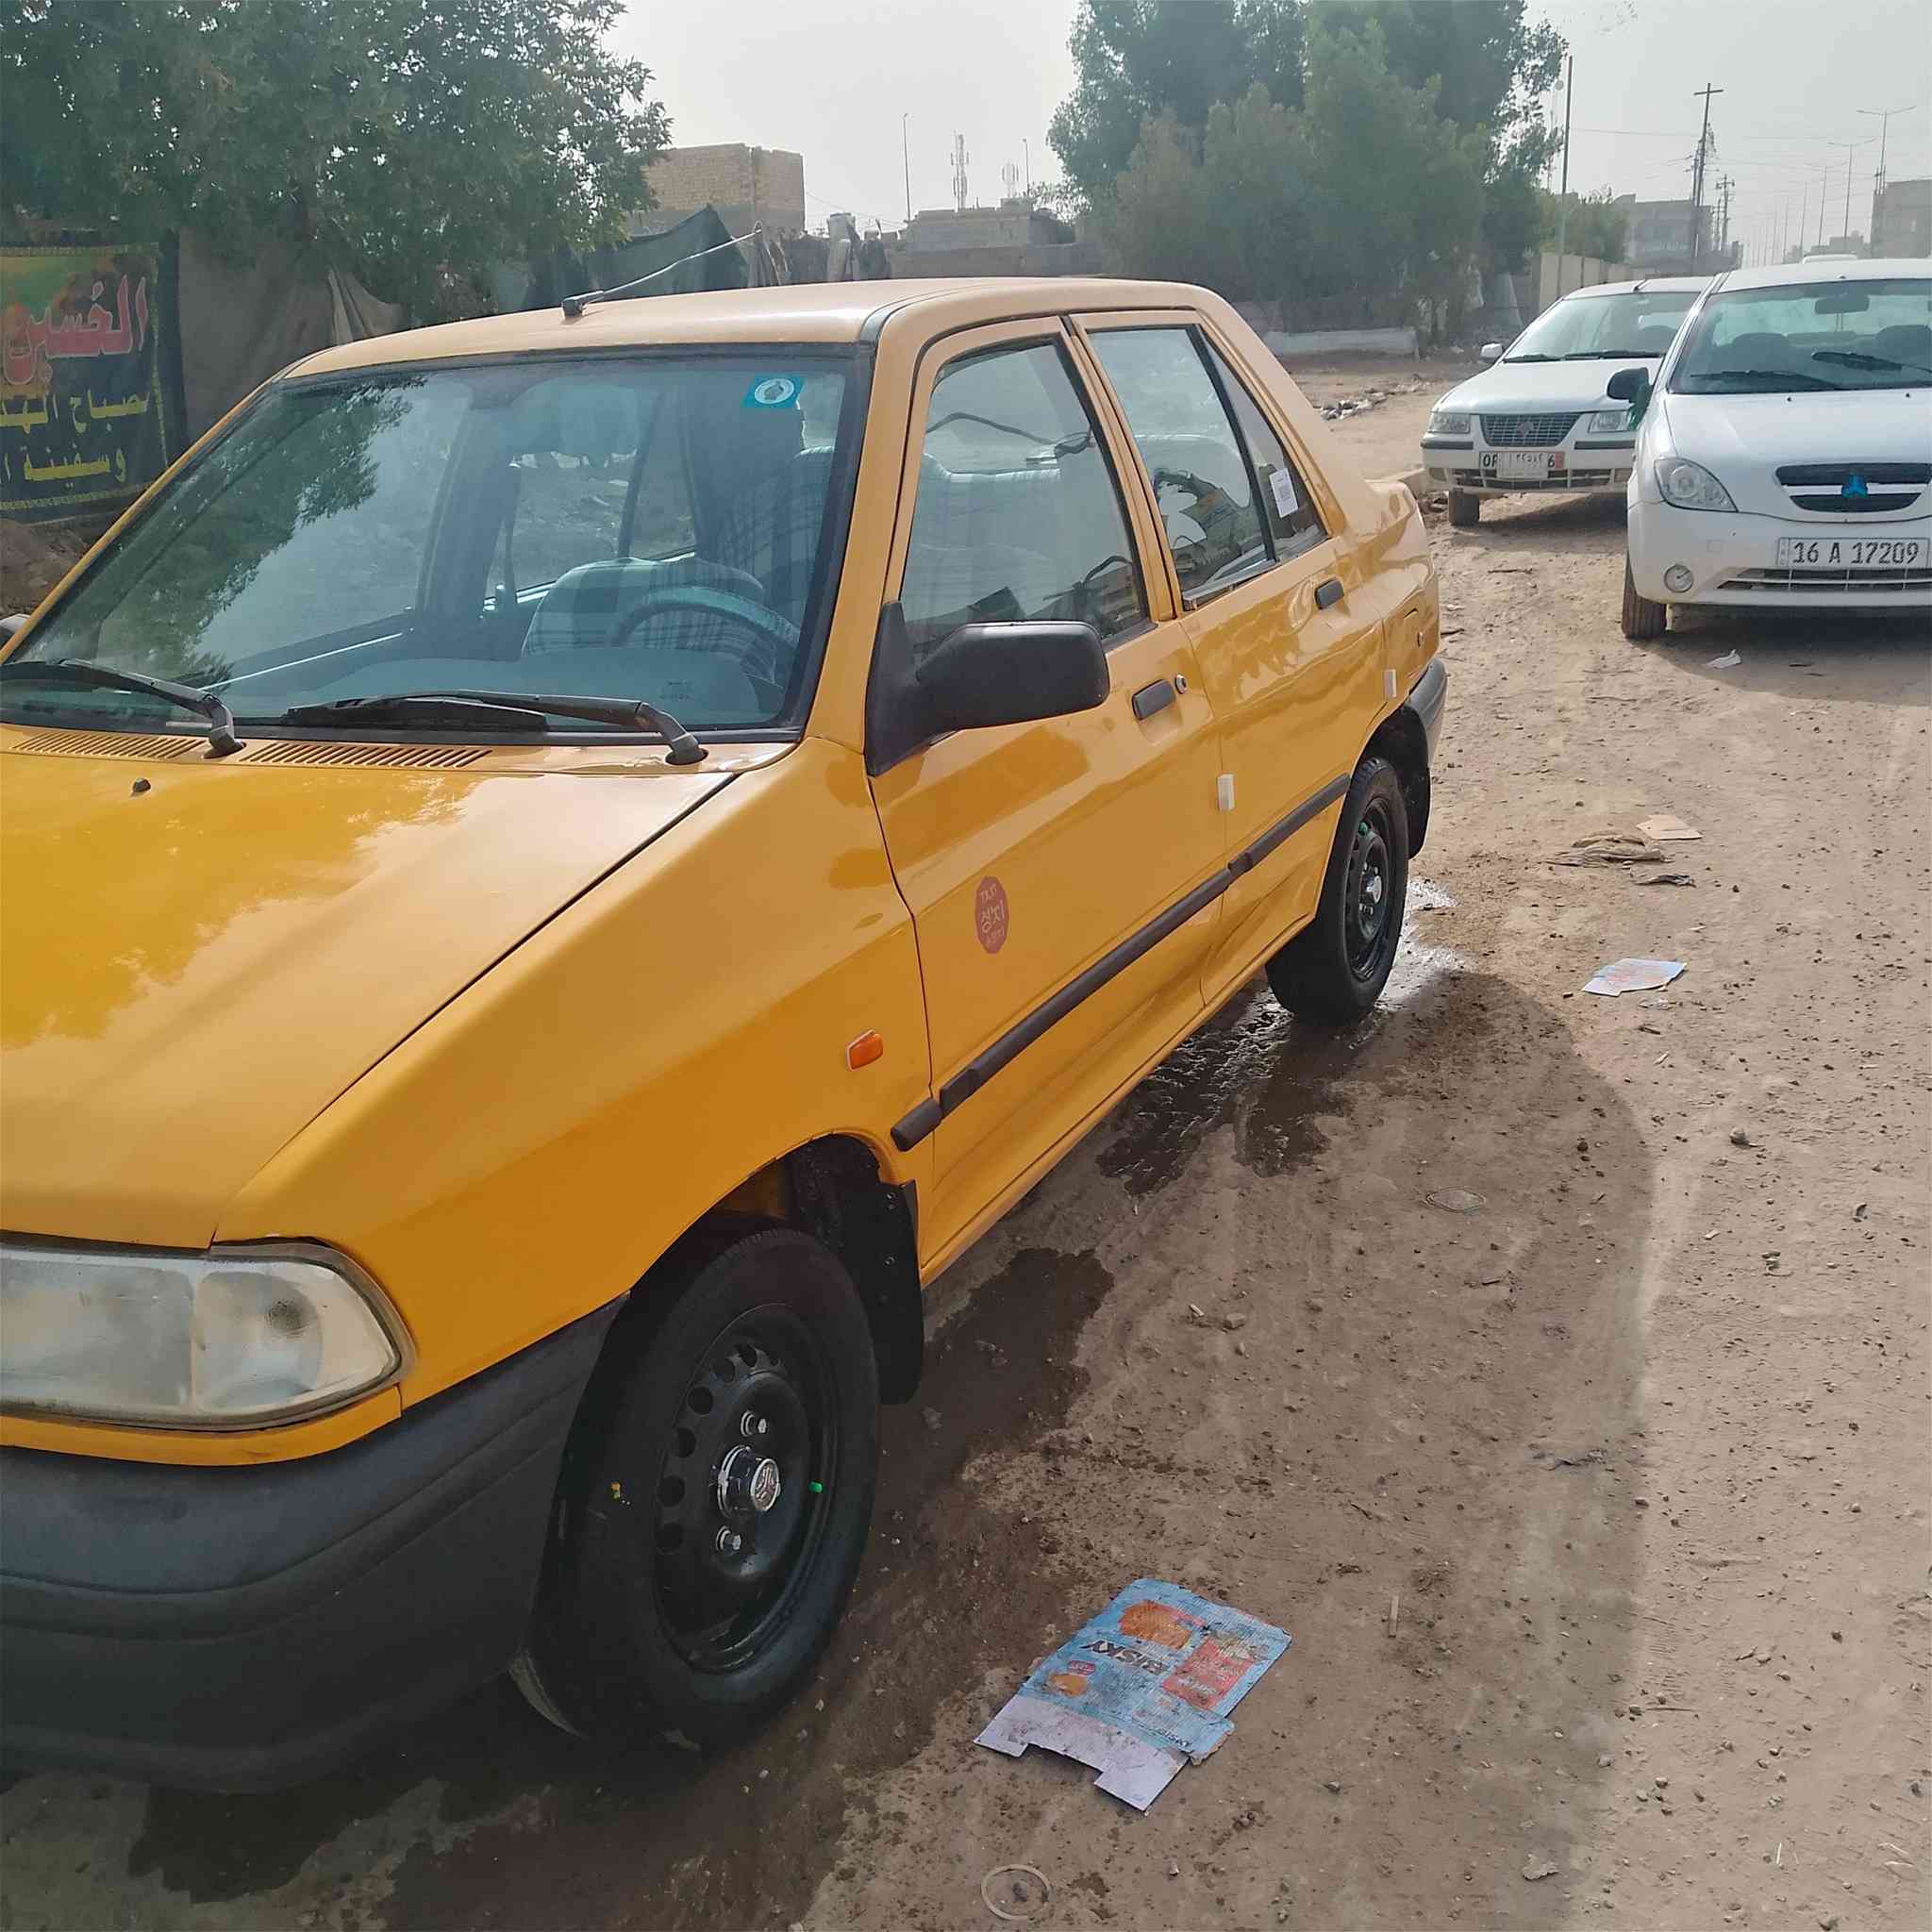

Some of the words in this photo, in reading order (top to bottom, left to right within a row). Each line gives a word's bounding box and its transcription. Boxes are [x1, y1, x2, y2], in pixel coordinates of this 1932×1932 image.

[1793, 542, 1819, 564] 16
[1828, 542, 1841, 564] A
[1851, 542, 1920, 565] 17209
